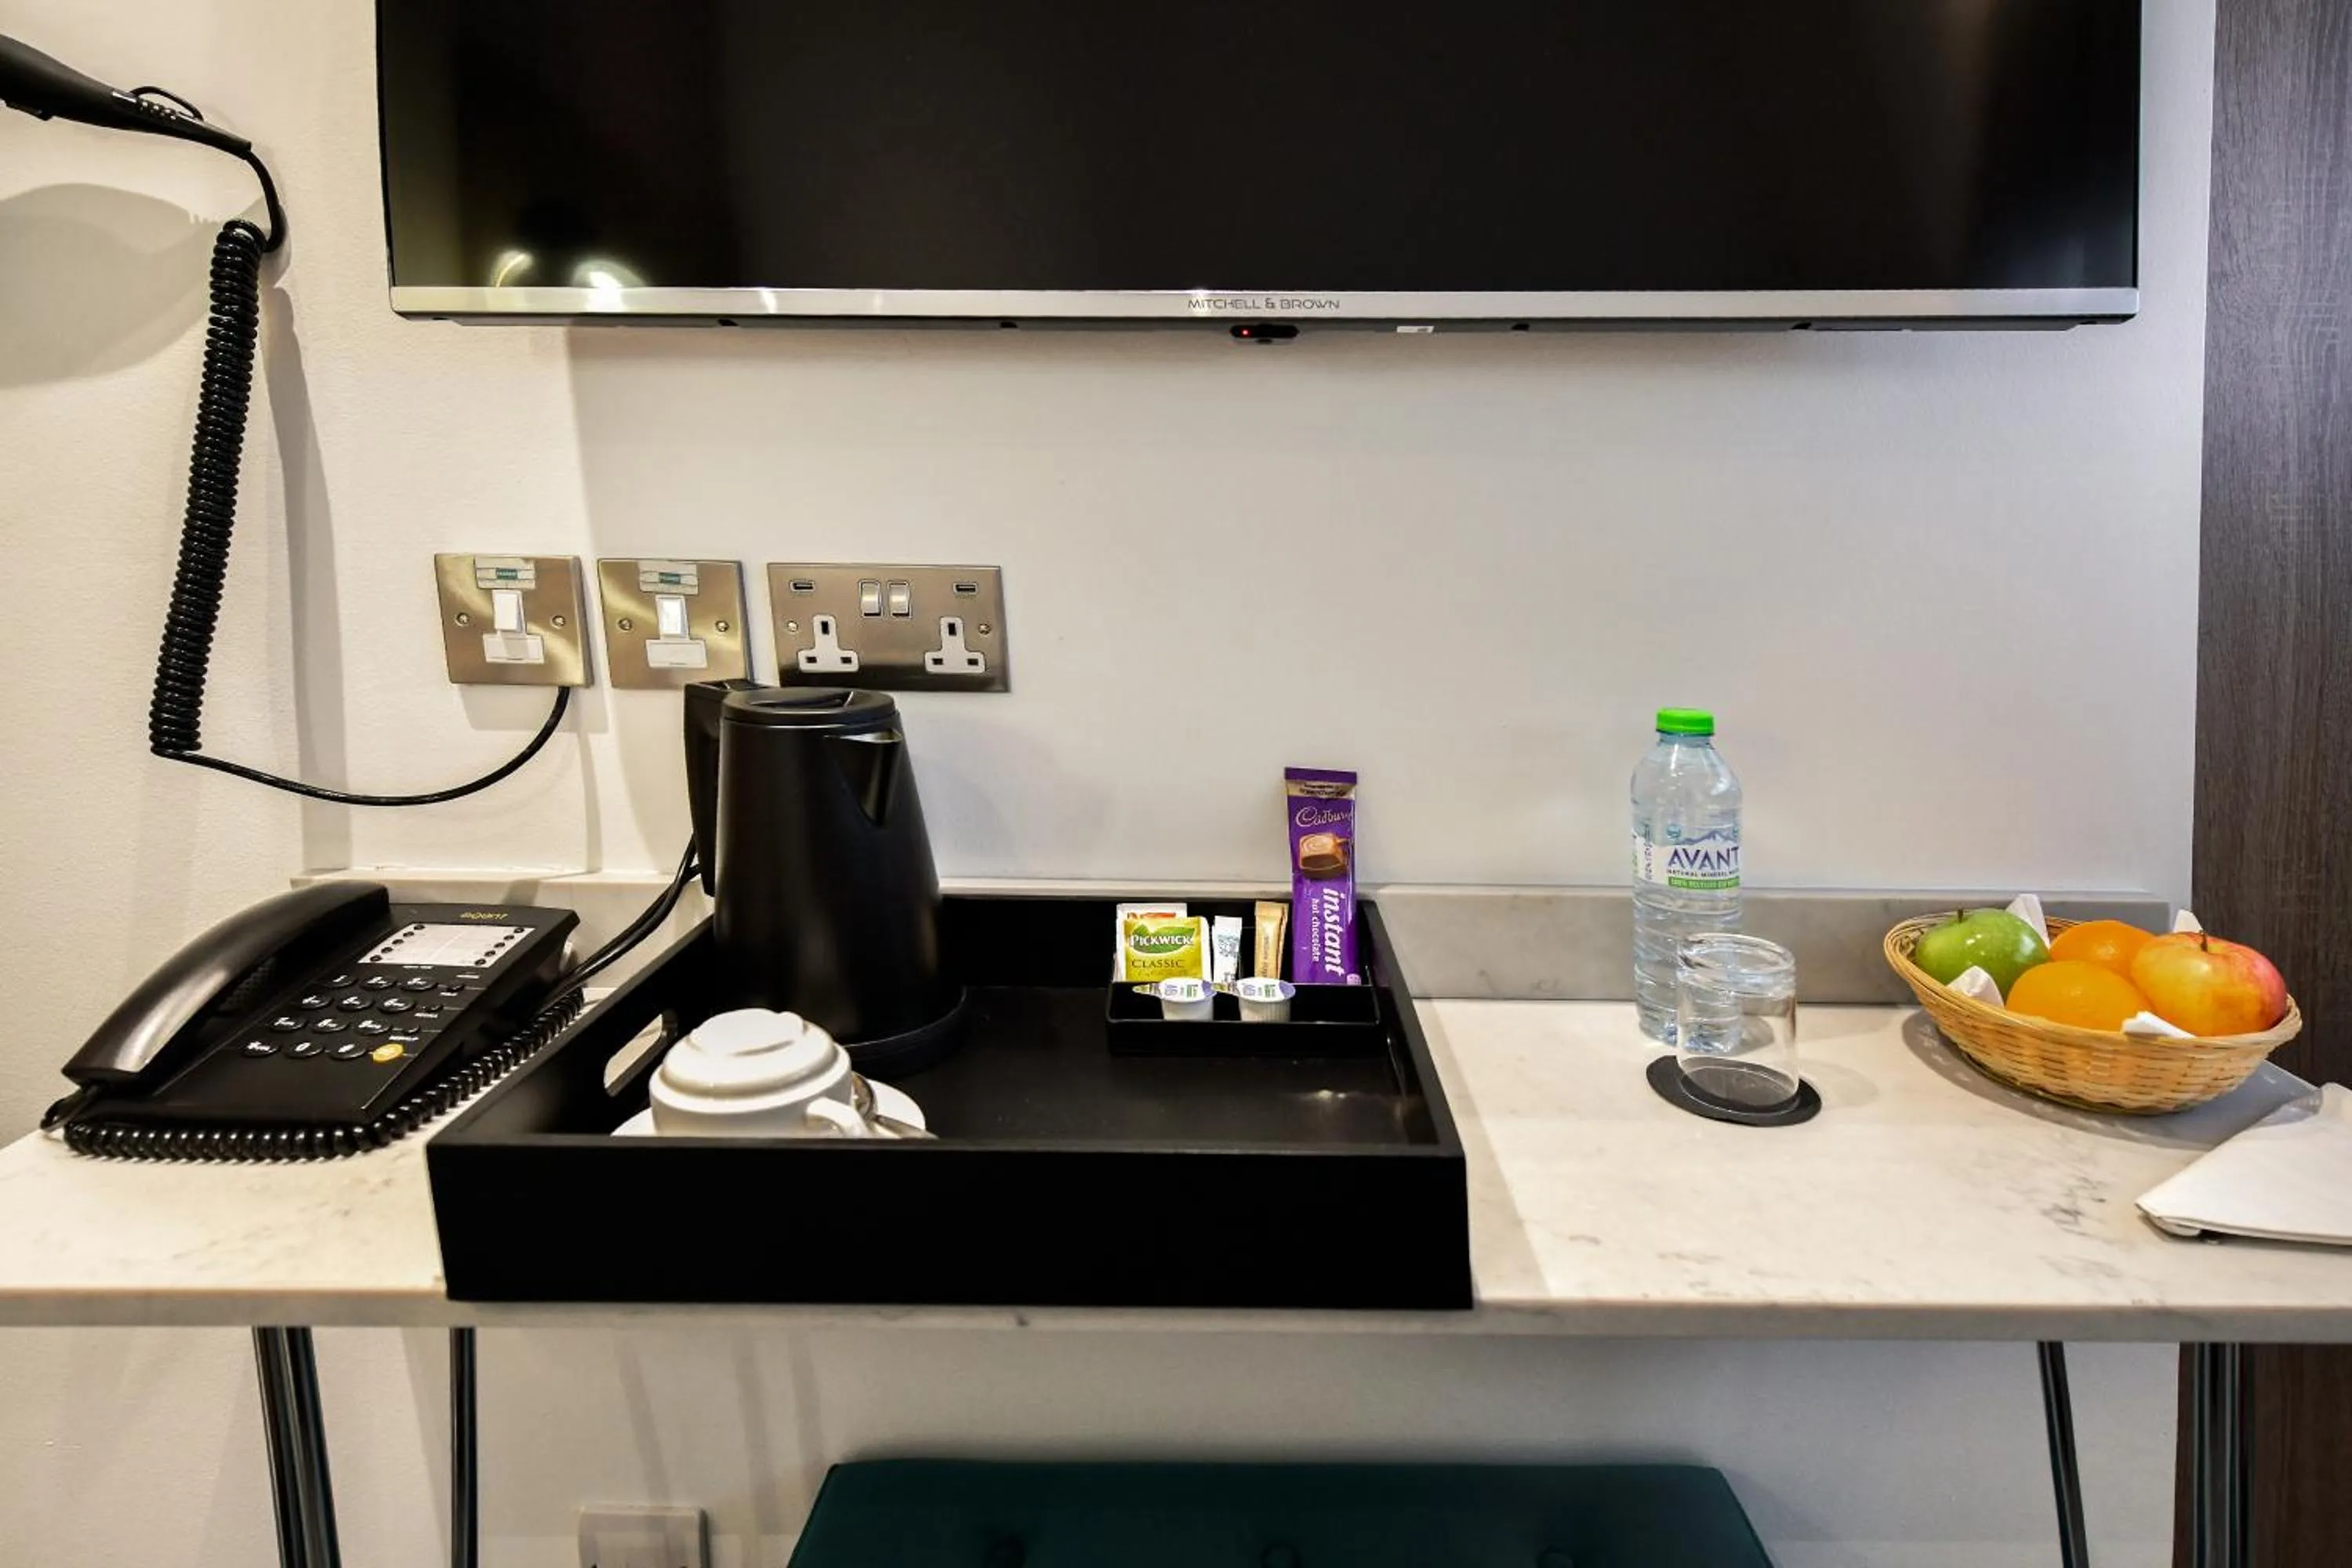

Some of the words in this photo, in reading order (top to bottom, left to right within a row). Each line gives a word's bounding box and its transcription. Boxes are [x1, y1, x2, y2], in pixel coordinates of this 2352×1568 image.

[1187, 299, 1261, 310] MITCHELL
[1265, 297, 1276, 309] &
[1280, 299, 1341, 309] BROWN
[1668, 847, 1739, 870] AVANT
[1130, 933, 1192, 949] PICKWICK
[1312, 916, 1321, 963] chocolate
[1323, 887, 1346, 977] instant
[1131, 959, 1185, 969] CLASSIC
